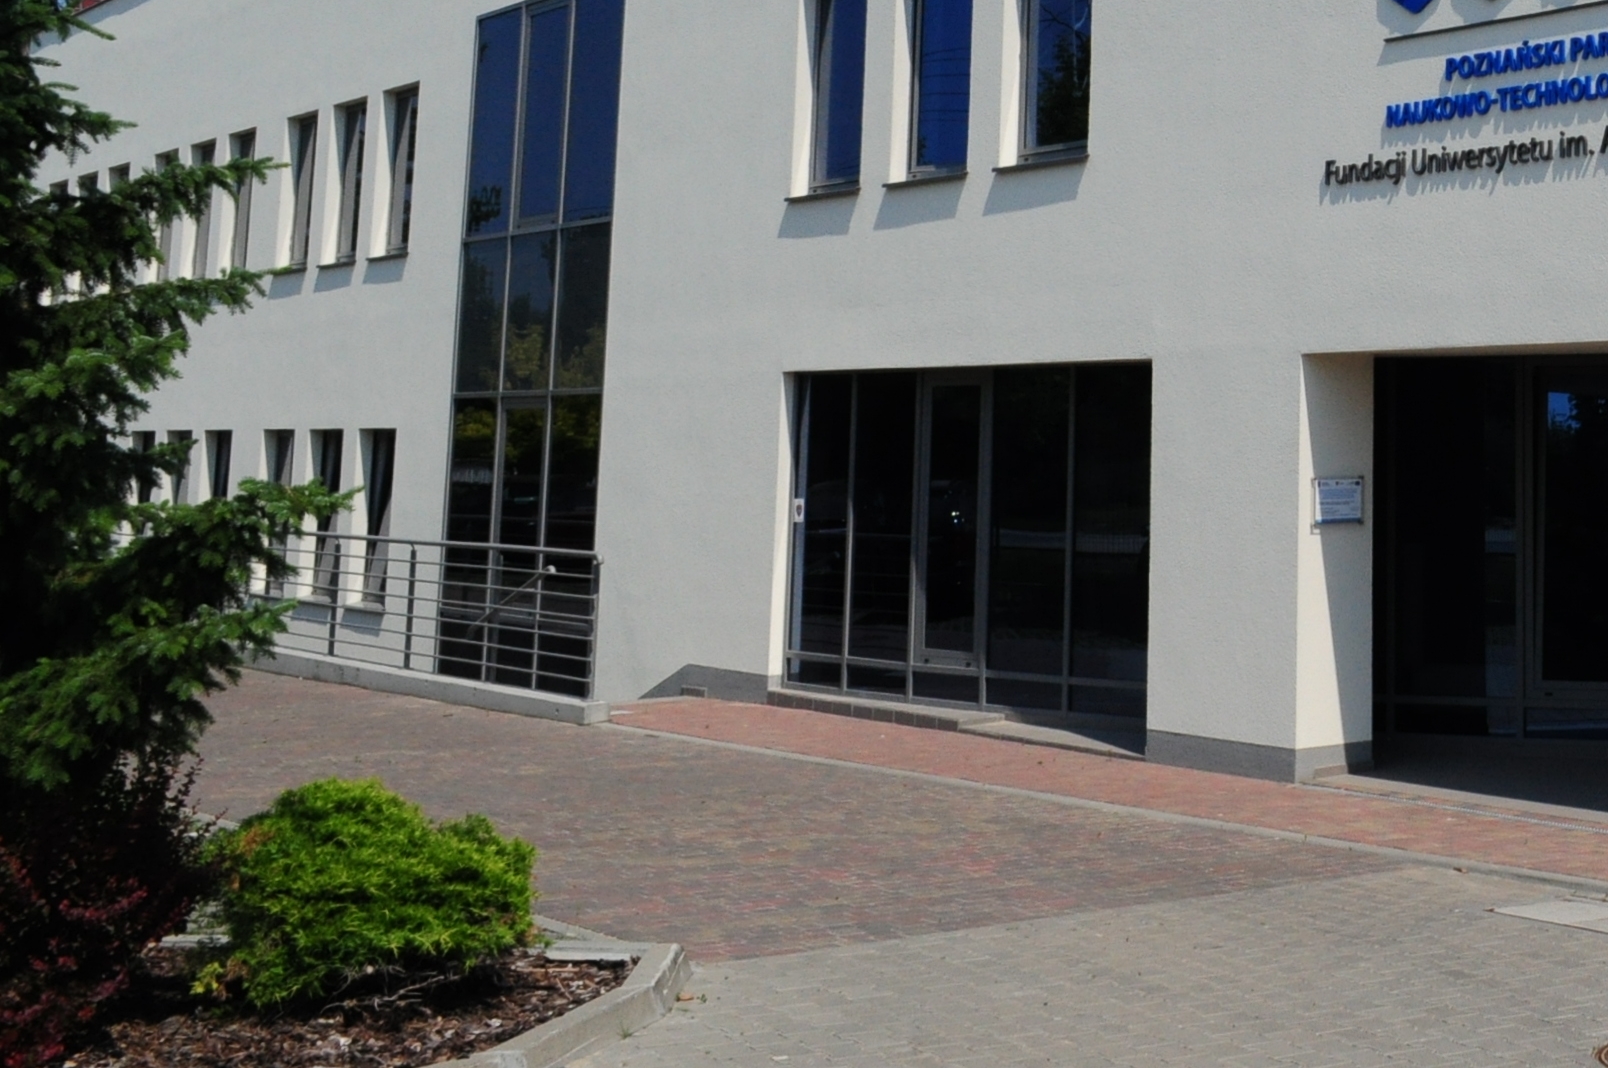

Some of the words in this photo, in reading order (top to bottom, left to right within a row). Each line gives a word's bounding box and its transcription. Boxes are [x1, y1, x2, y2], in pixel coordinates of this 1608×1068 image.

[1445, 39, 1566, 81] POZNAŃSKI
[1324, 153, 1408, 186] Fundacji
[1411, 137, 1554, 175] Uniwersytetu
[1559, 131, 1595, 159] im.
